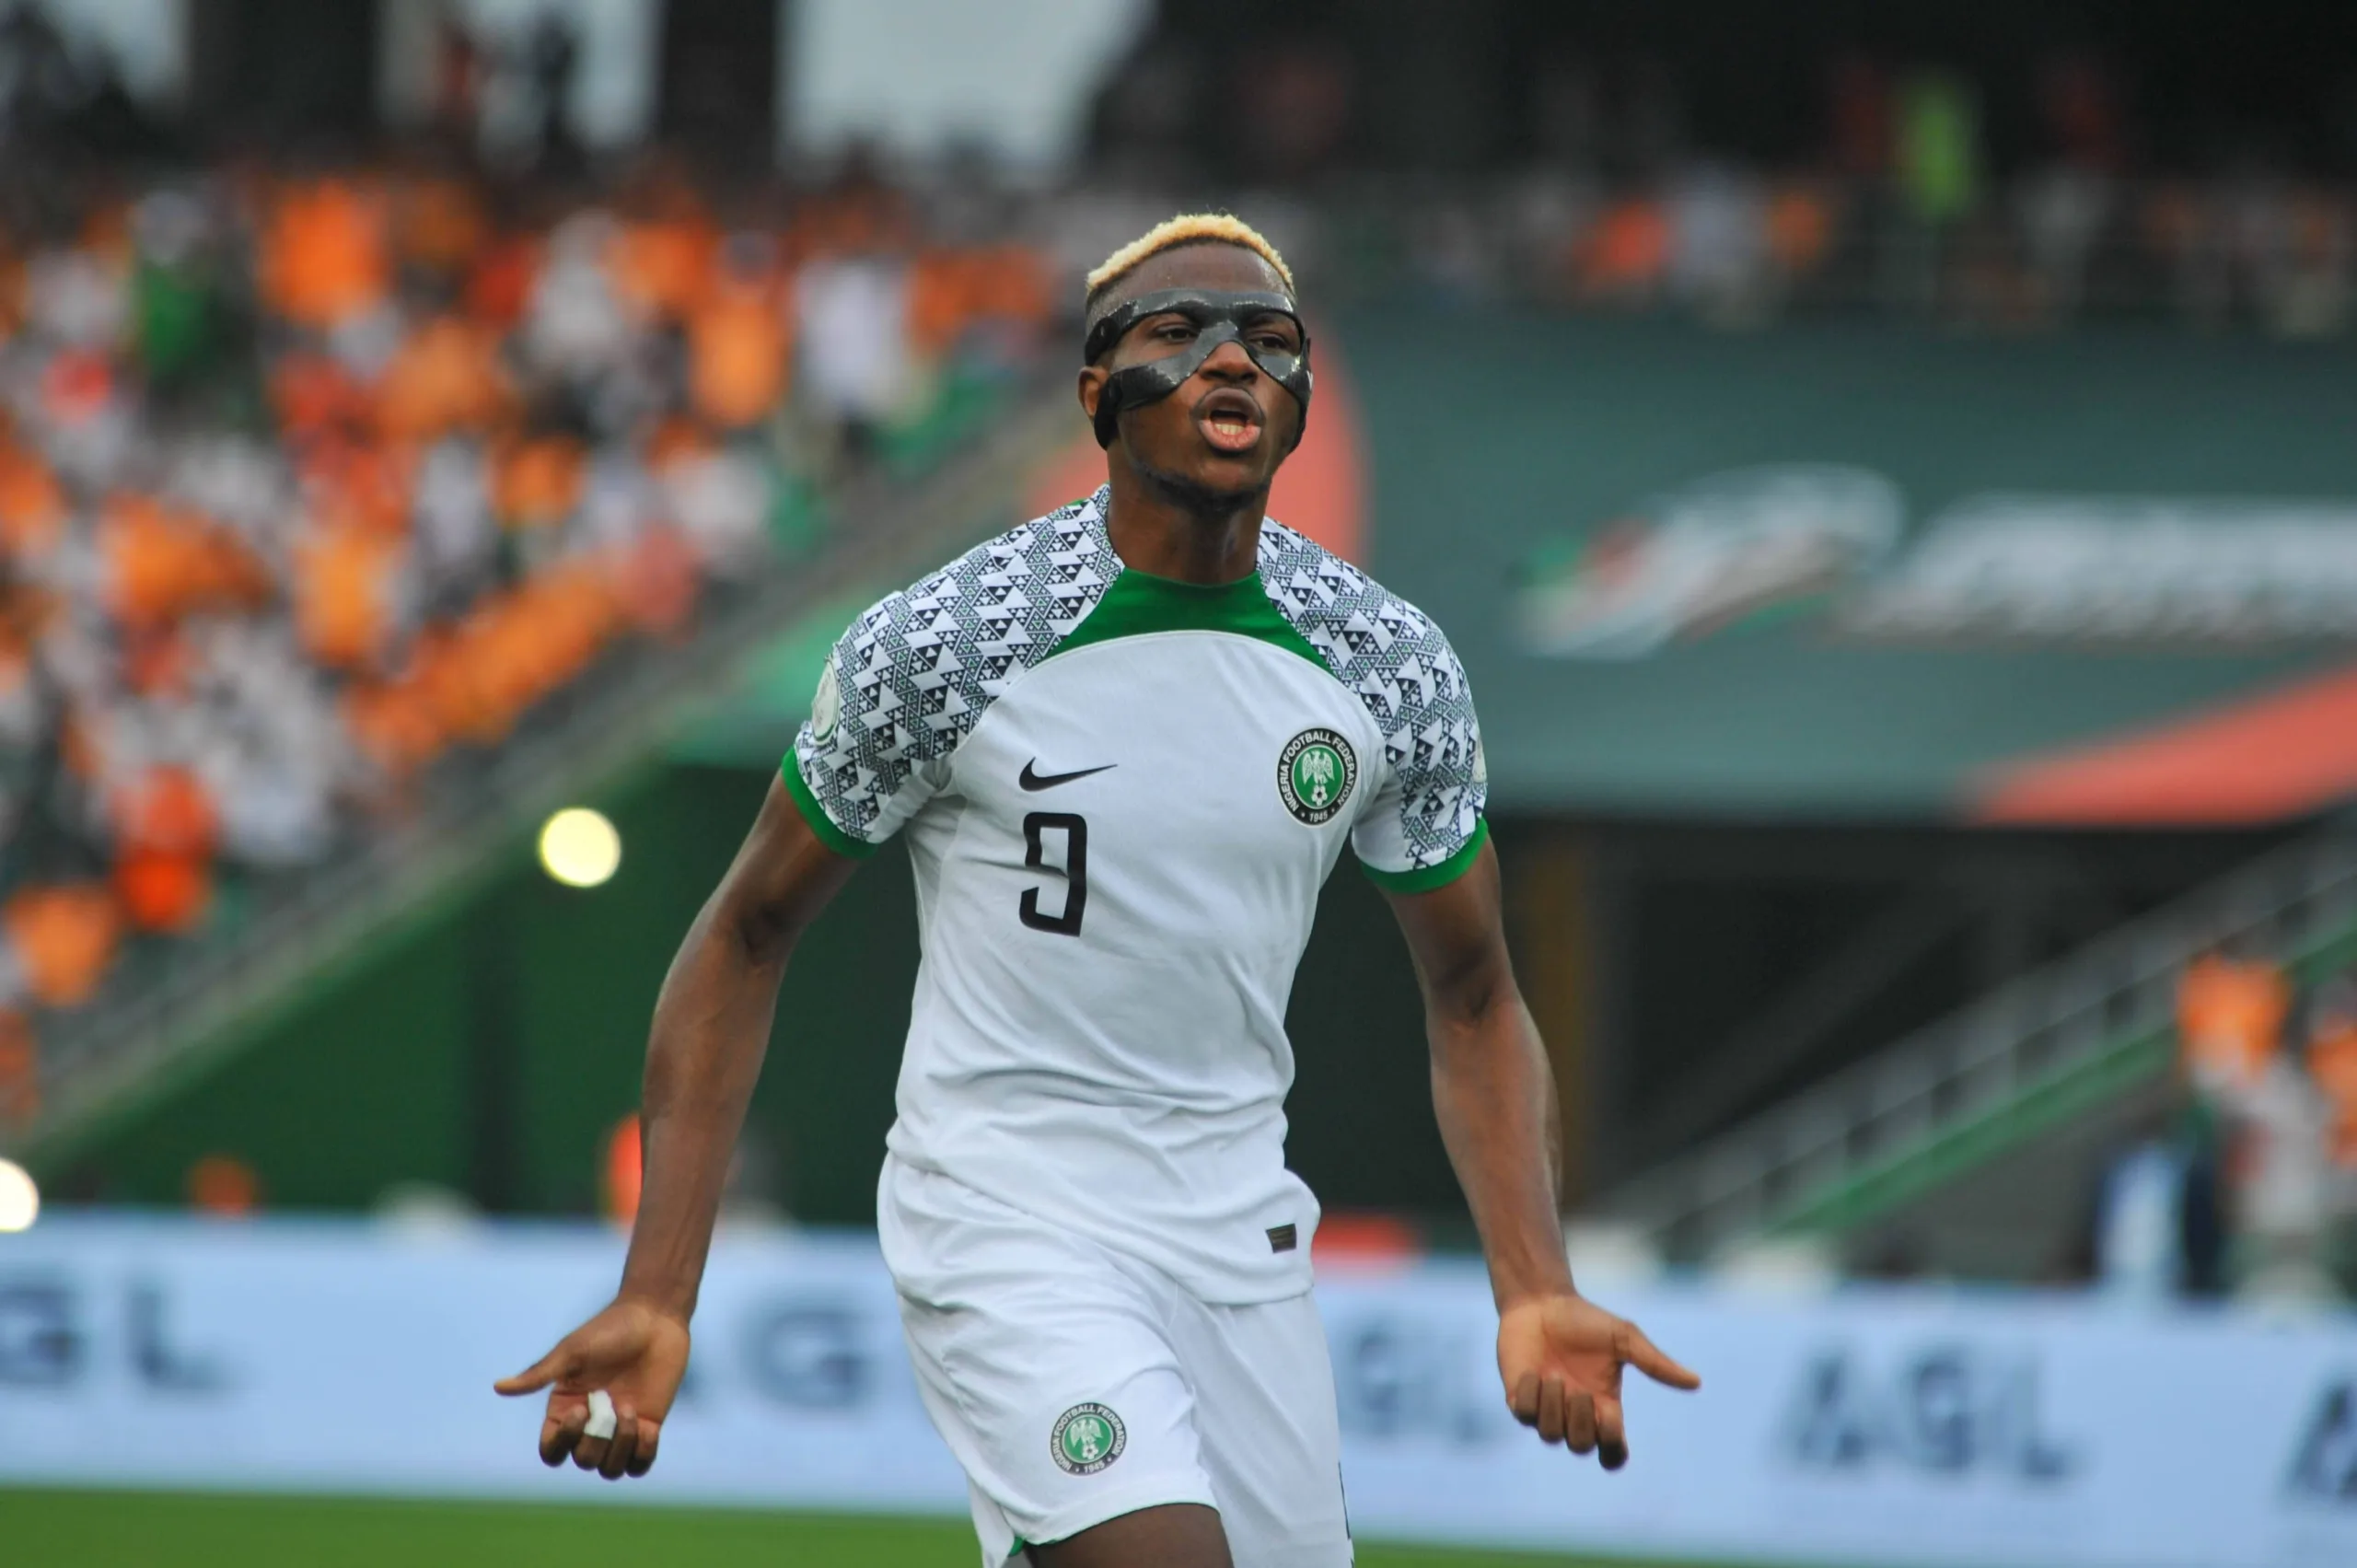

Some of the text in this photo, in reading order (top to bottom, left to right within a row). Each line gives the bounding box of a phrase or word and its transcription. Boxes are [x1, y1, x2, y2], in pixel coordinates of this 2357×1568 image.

[1280, 730, 1355, 812] NIGERIA FOOTBALL FEDERATION
[1309, 811, 1329, 822] 1945
[1019, 811, 1087, 937] 9
[1053, 1404, 1096, 1436] FOOTBALL
